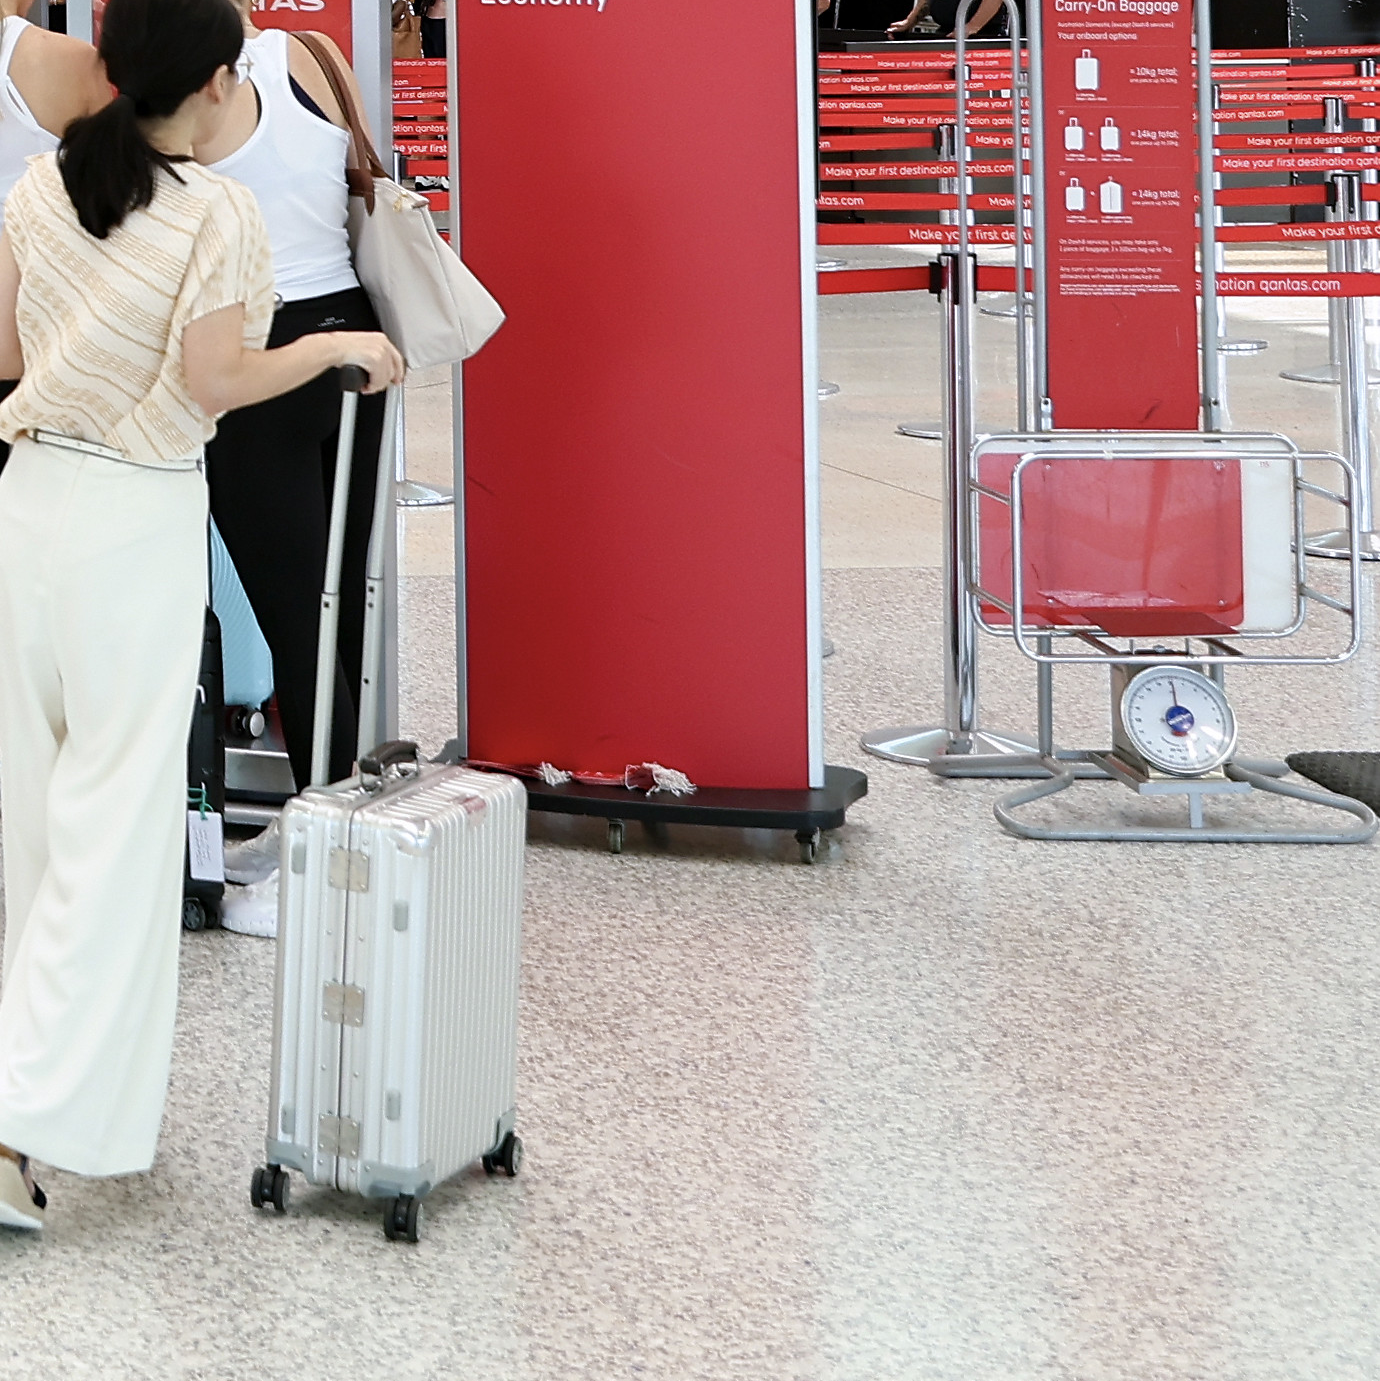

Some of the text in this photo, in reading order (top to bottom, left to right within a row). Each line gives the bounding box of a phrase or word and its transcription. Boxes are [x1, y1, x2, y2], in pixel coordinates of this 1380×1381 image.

[1055, 0, 1178, 15] Carry-On Baggage
[826, 163, 1016, 177] Make your first destination antas.com
[1257, 278, 1340, 297] qantas.com
